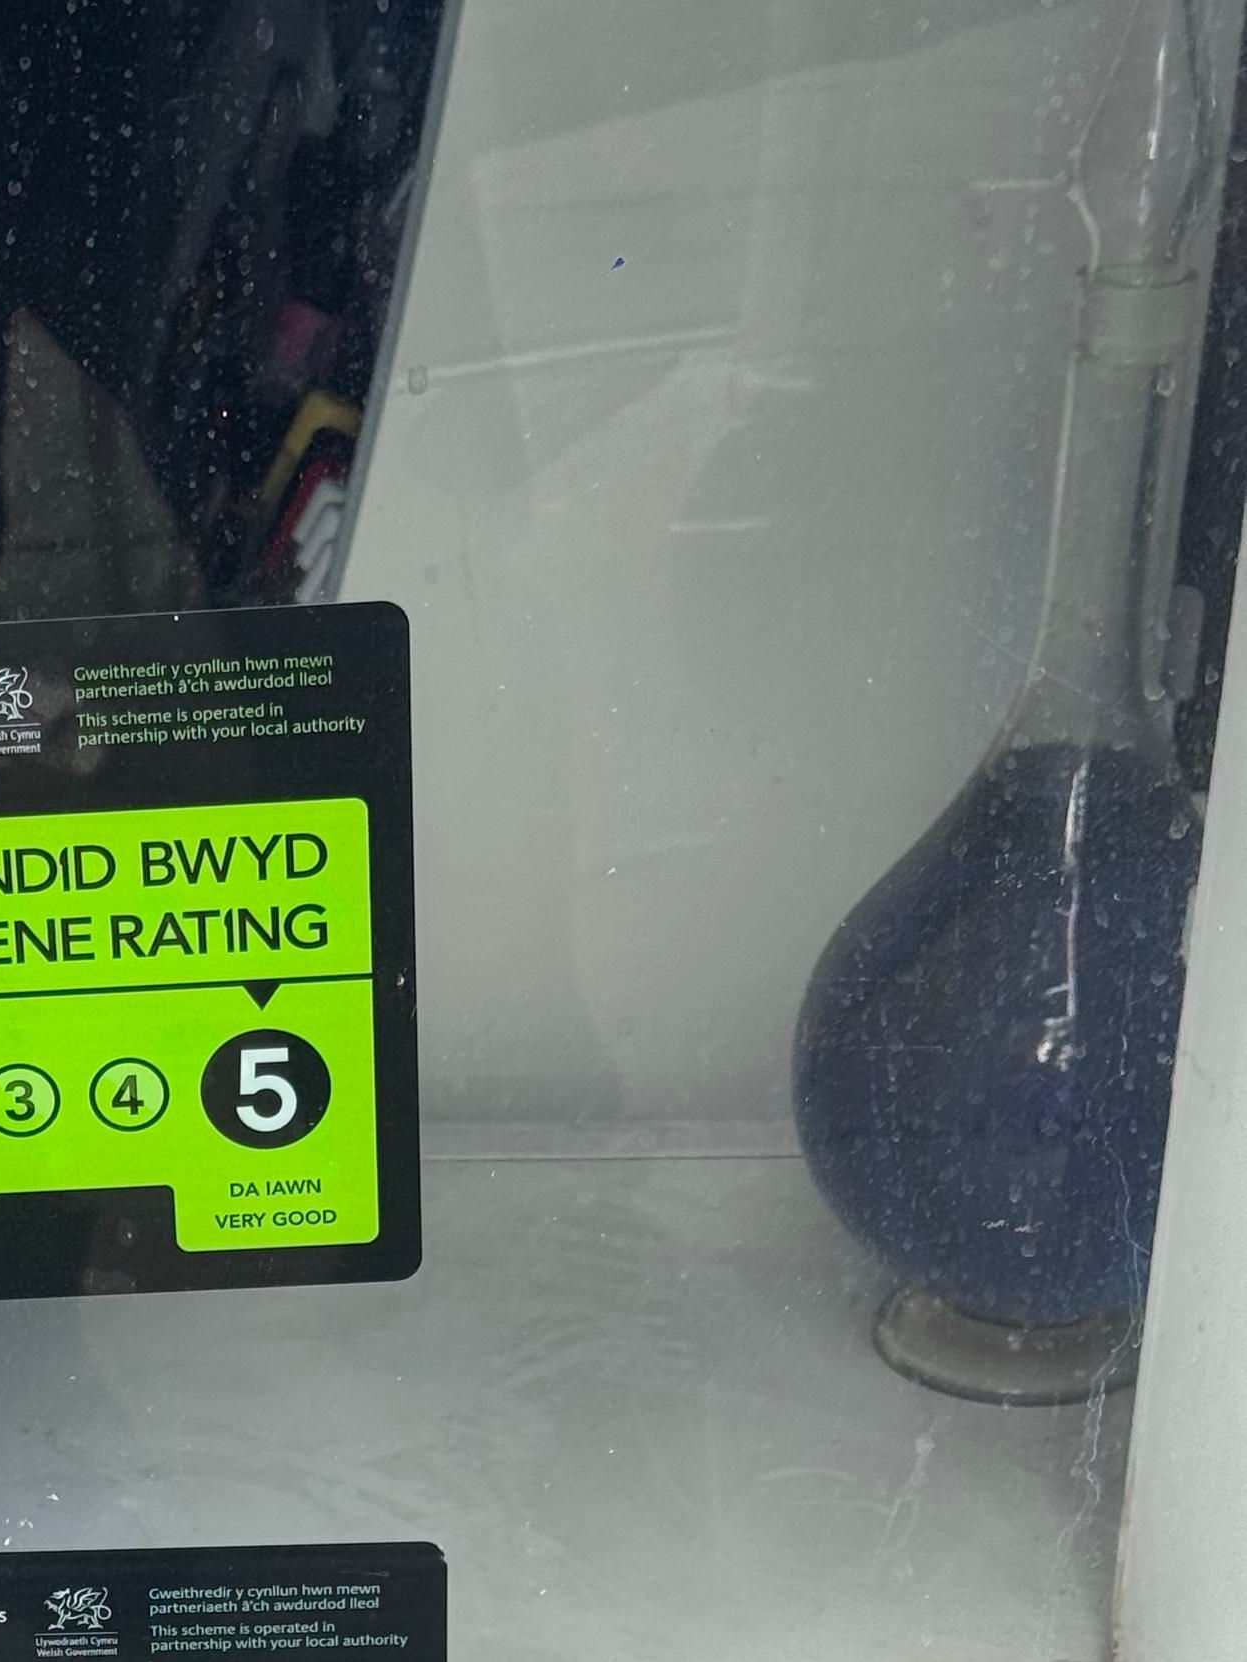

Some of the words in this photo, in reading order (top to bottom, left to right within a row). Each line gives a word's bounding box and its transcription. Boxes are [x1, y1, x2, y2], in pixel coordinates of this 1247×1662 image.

[74, 663, 167, 682] Gweithredir
[171, 666, 180, 679] y
[184, 660, 240, 678] cynllun
[245, 658, 280, 671] hwn
[284, 655, 333, 669] mewn
[75, 681, 173, 703] partneriaeth
[214, 673, 295, 691] awdurdod
[299, 671, 332, 687] lleol
[76, 713, 106, 728] This
[111, 709, 171, 727] scheme
[177, 708, 188, 722] is
[192, 705, 264, 725] operated
[269, 702, 283, 717] in
[10, 729, 41, 742] Cymru
[78, 727, 168, 750] partnership
[172, 725, 208, 742] with
[211, 725, 246, 741] your
[251, 719, 288, 736] local
[292, 716, 366, 734] authority
[142, 833, 328, 885] BWYD
[112, 904, 328, 959] RATING
[5, 1080, 36, 1121] 3
[111, 1073, 146, 1115] 4
[236, 1048, 296, 1132] 5
[230, 1182, 261, 1198] DA
[266, 1178, 321, 1196] IAWN
[215, 1212, 267, 1230] VERY
[272, 1209, 337, 1227] GOOD
[149, 1587, 232, 1600] Gweithredir
[235, 1590, 244, 1599] y
[247, 1585, 298, 1599] cynllun
[302, 1585, 332, 1595] hwn
[336, 1584, 380, 1595] mewn
[149, 1600, 237, 1617] partneriaeth
[273, 1598, 346, 1611] awdurdod
[350, 1597, 379, 1609] lleol
[151, 1625, 178, 1637] This
[181, 1624, 235, 1636] scheme
[240, 1623, 250, 1634] is
[254, 1621, 318, 1636] operated
[323, 1621, 335, 1632] in
[90, 1636, 118, 1647] Cymru
[151, 1636, 231, 1654] partnership
[235, 1636, 267, 1649] with
[270, 1638, 301, 1650] your
[305, 1634, 338, 1646] local
[342, 1633, 408, 1649] authority
[37, 1647, 63, 1658] Welsh
[65, 1647, 117, 1657] Government
